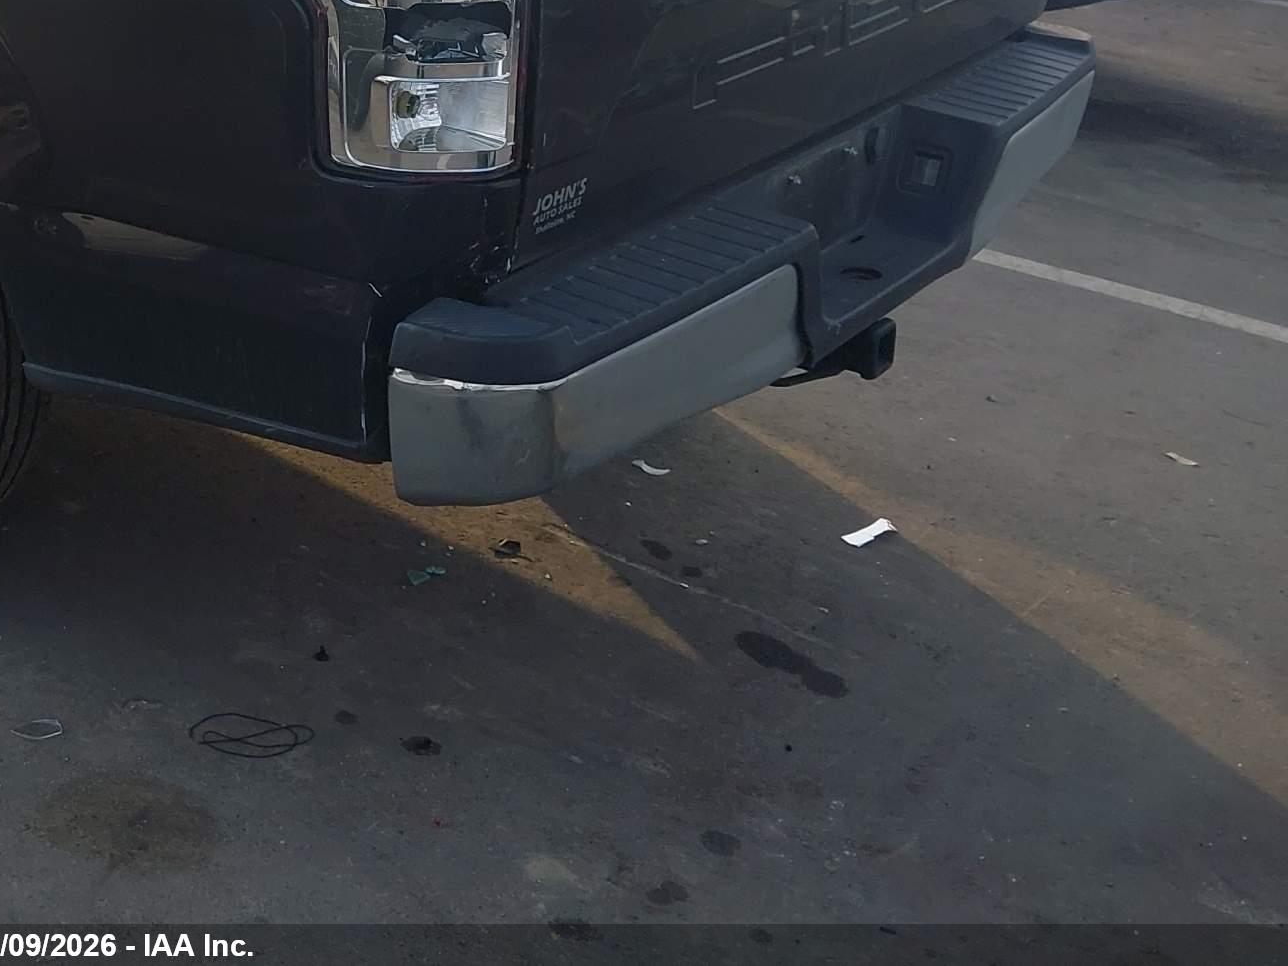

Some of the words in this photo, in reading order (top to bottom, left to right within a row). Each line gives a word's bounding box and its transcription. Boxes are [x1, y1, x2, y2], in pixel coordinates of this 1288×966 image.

[533, 177, 587, 215] JOHN'S
[533, 208, 557, 226] AUTO
[558, 196, 583, 214] SALES
